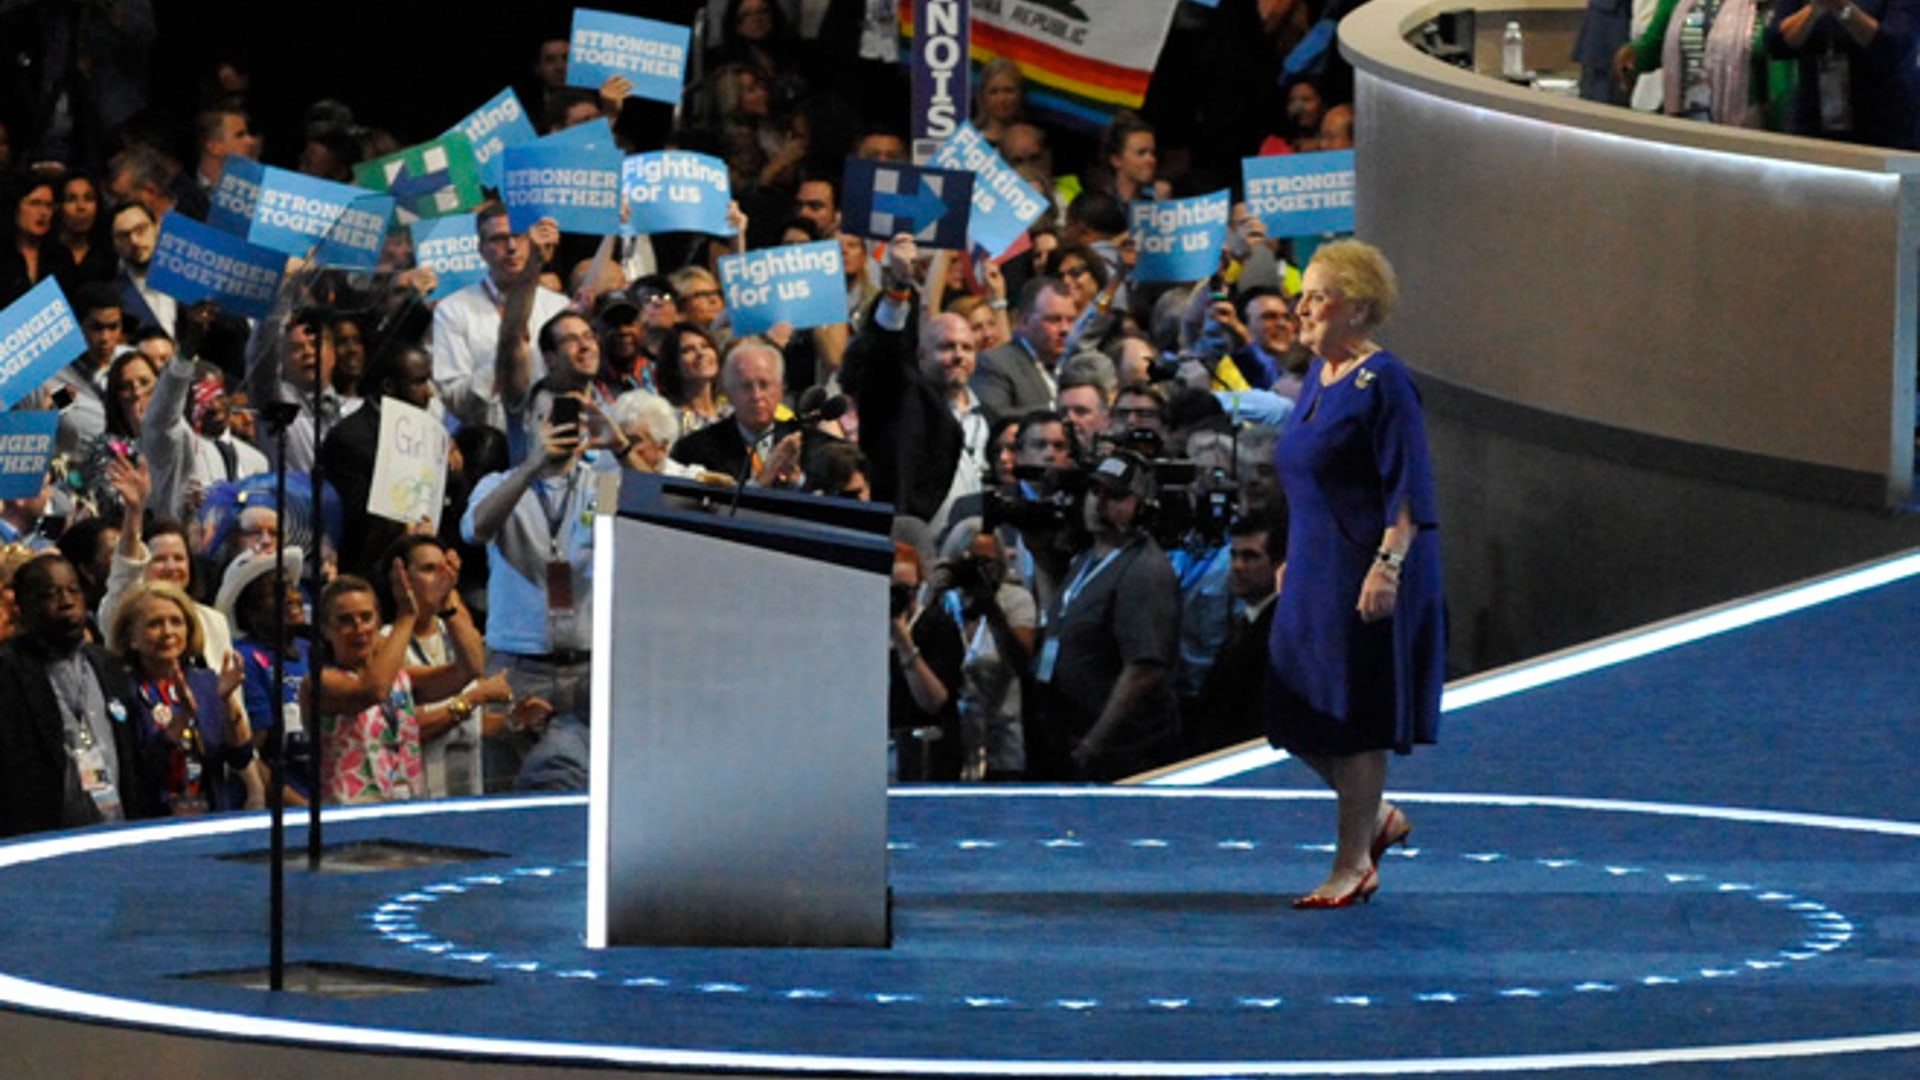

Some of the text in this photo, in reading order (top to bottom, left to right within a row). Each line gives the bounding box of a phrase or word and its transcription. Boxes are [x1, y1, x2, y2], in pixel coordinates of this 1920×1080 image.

[575, 29, 682, 60] STRONGER
[574, 47, 680, 78] TOGETHER
[506, 169, 618, 189] STRONGER
[623, 151, 728, 191] Fighting
[953, 127, 1039, 221] Fighting
[263, 188, 384, 231] STRONGER
[507, 188, 617, 208] TOGETHER
[668, 183, 702, 204] us
[259, 206, 379, 252] TOGETHER
[1134, 229, 1209, 253] for us
[156, 248, 273, 299] TOGETHER
[161, 232, 278, 284] STRONGER
[724, 247, 840, 284] Fighting
[729, 279, 811, 309] for us
